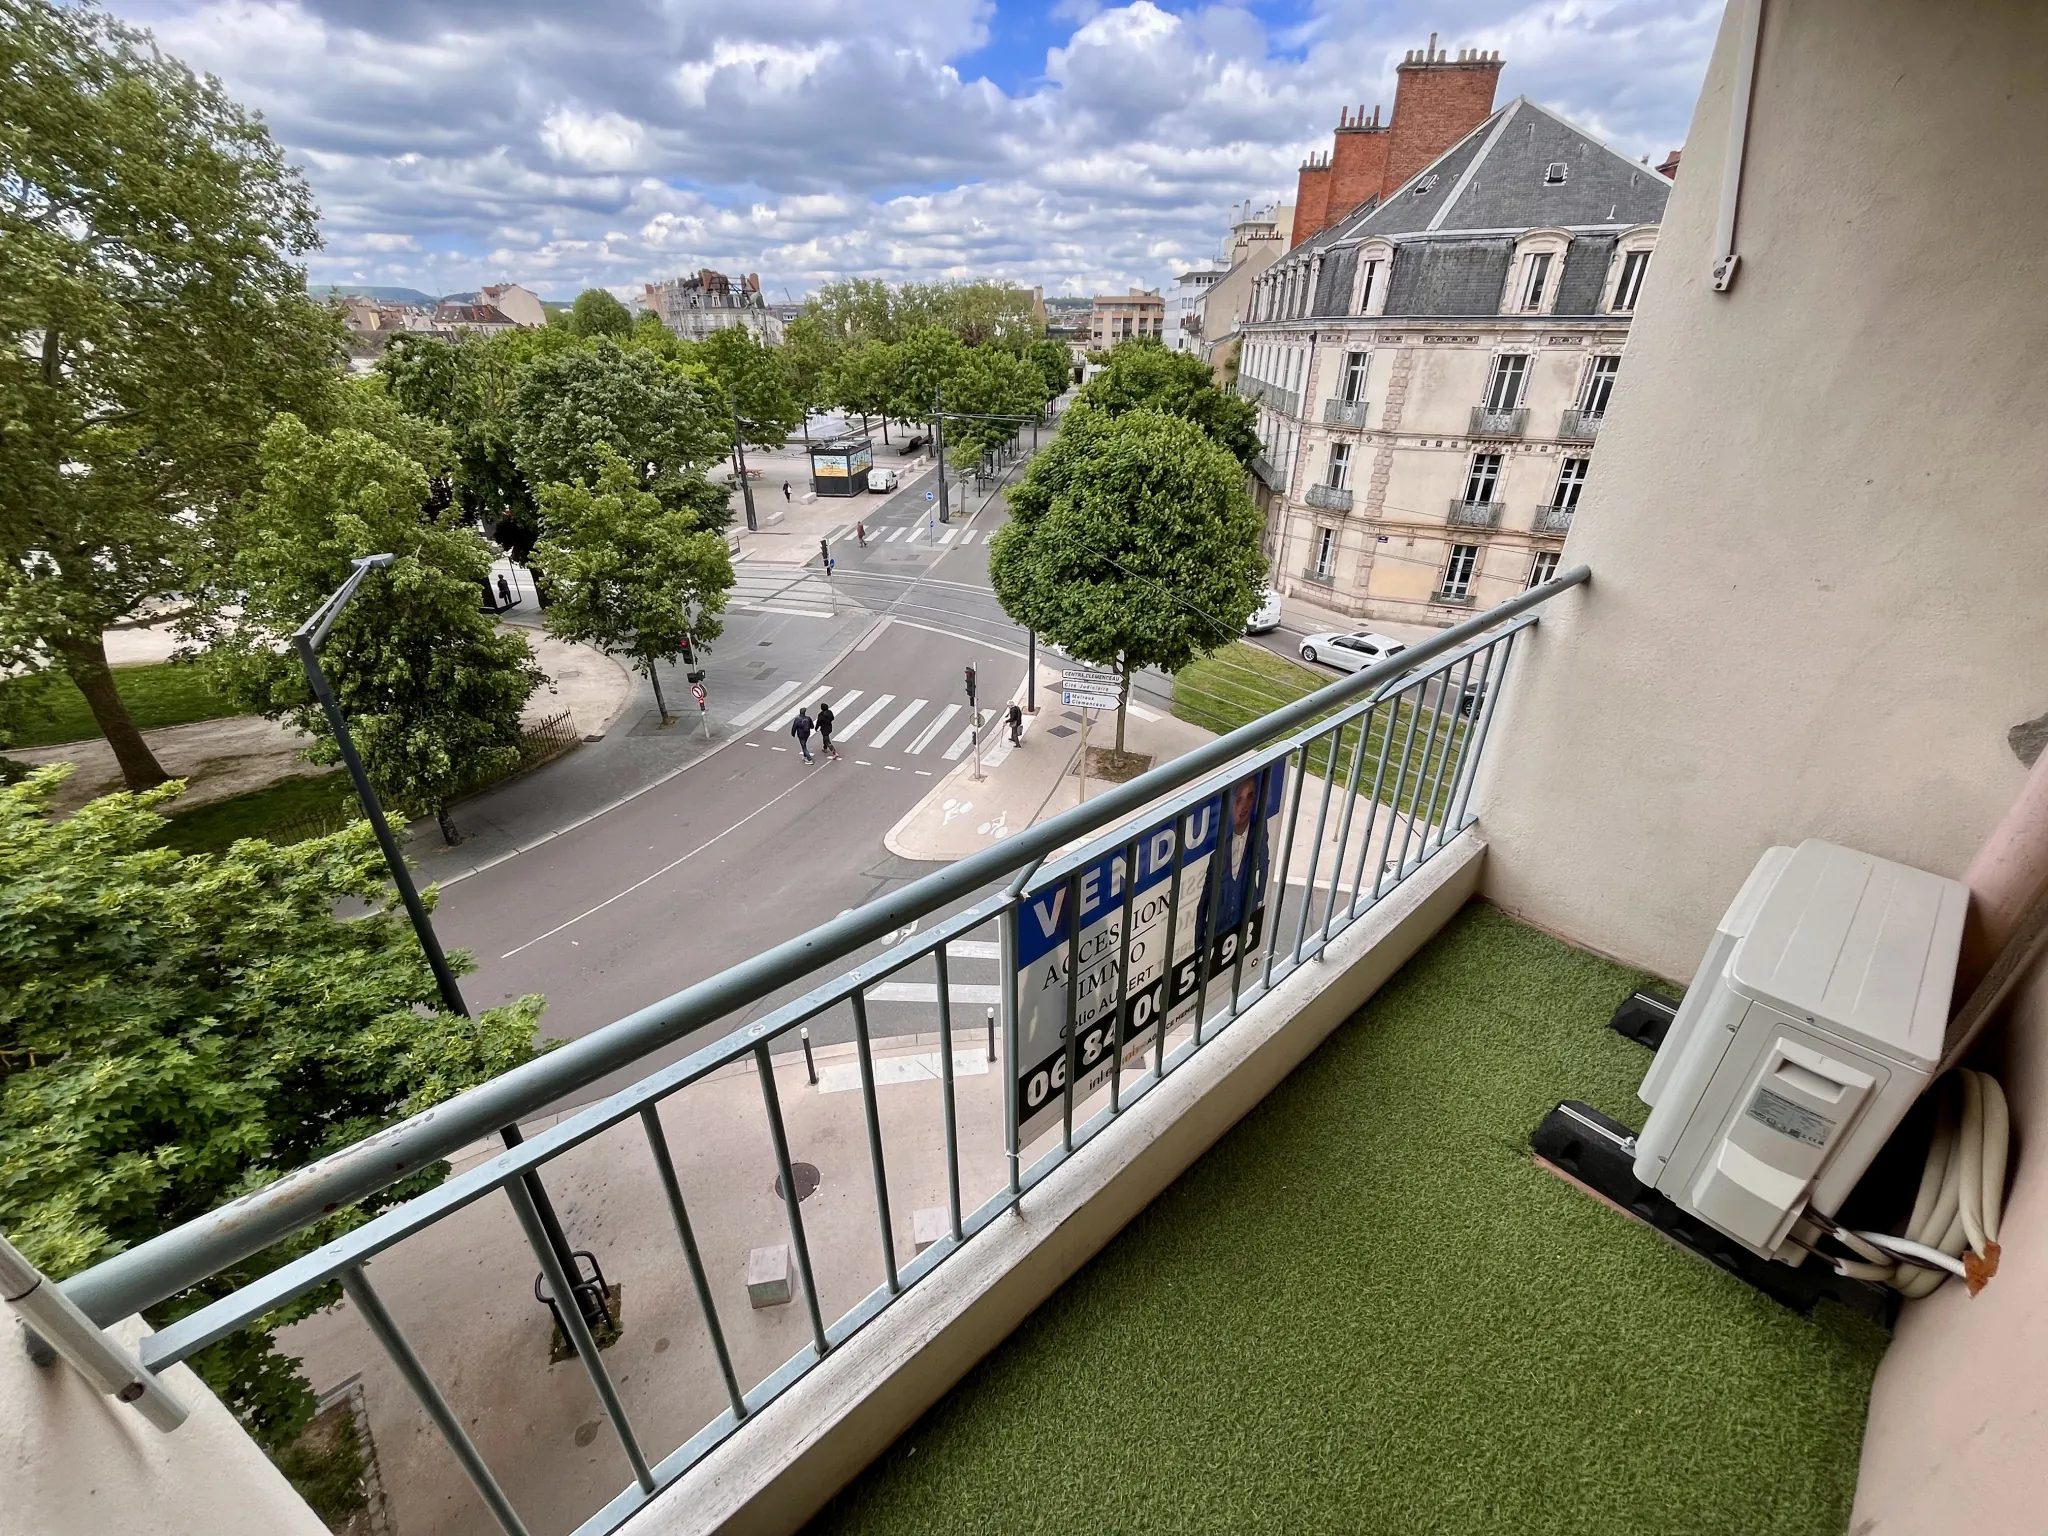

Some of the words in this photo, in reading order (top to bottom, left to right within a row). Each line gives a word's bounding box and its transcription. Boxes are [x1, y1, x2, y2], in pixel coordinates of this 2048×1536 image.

[1033, 805, 1211, 938] VENDU
[1042, 890, 1171, 991] ACCESION
[1099, 965, 1154, 1012] AUERT
[1027, 1053, 1067, 1107] 06
[1178, 947, 1215, 995] 5
[1147, 1019, 1174, 1046] AGCE
